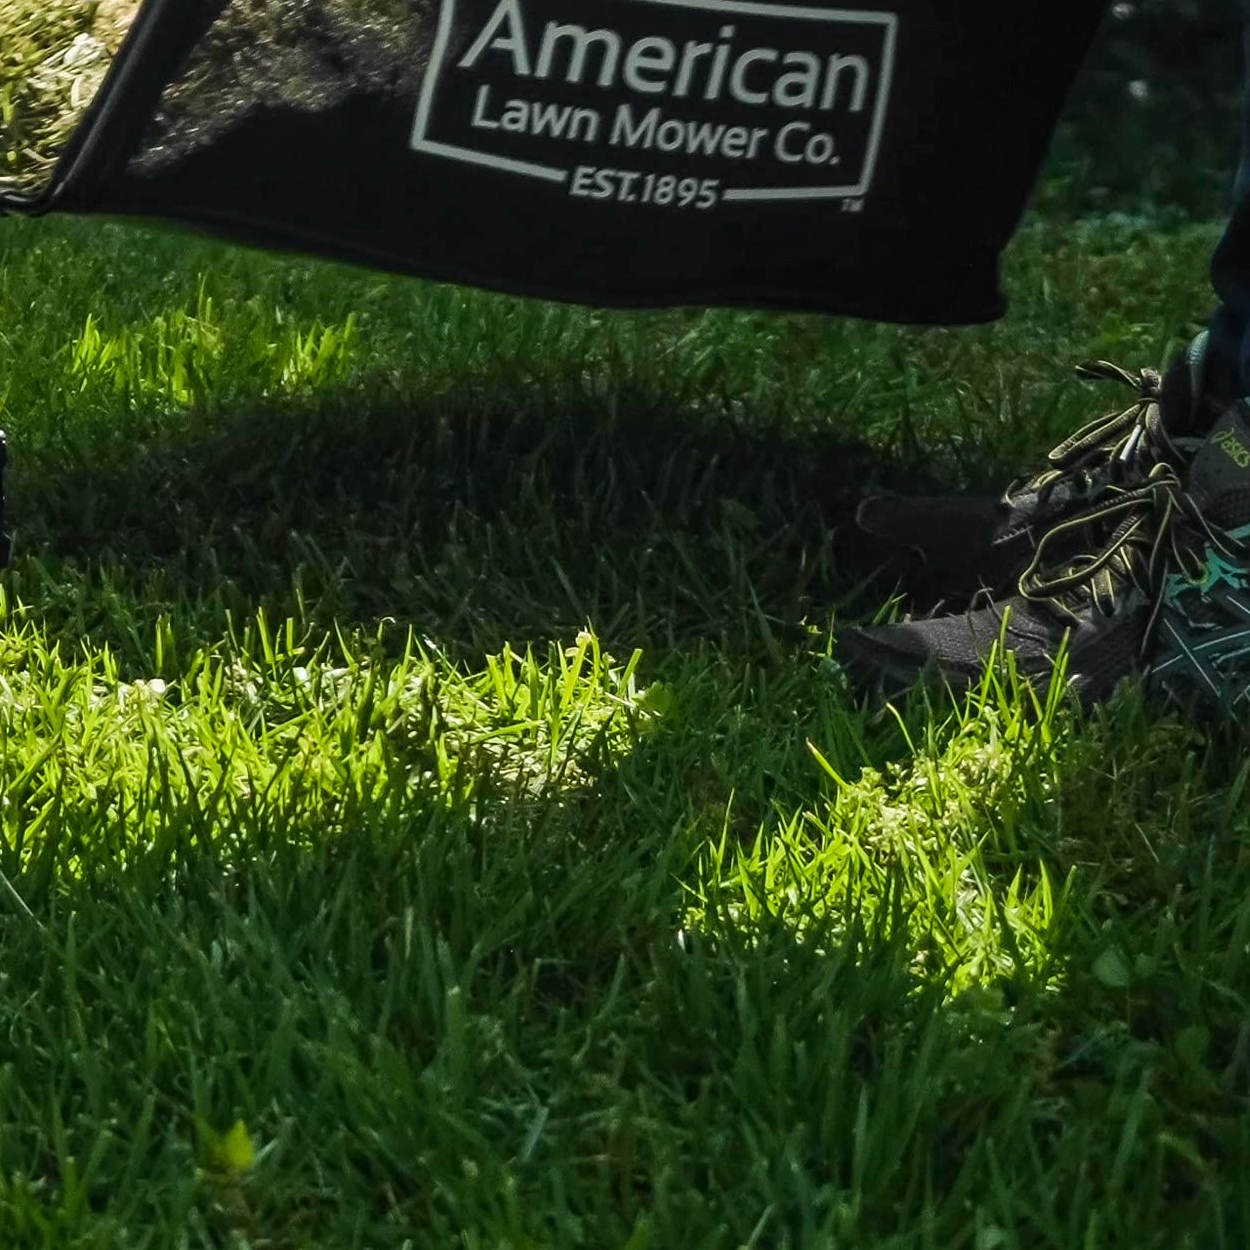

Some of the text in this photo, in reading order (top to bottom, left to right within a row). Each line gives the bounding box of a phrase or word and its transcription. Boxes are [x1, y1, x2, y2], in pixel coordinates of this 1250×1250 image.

[471, 85, 842, 166] Lawn Mower Co.
